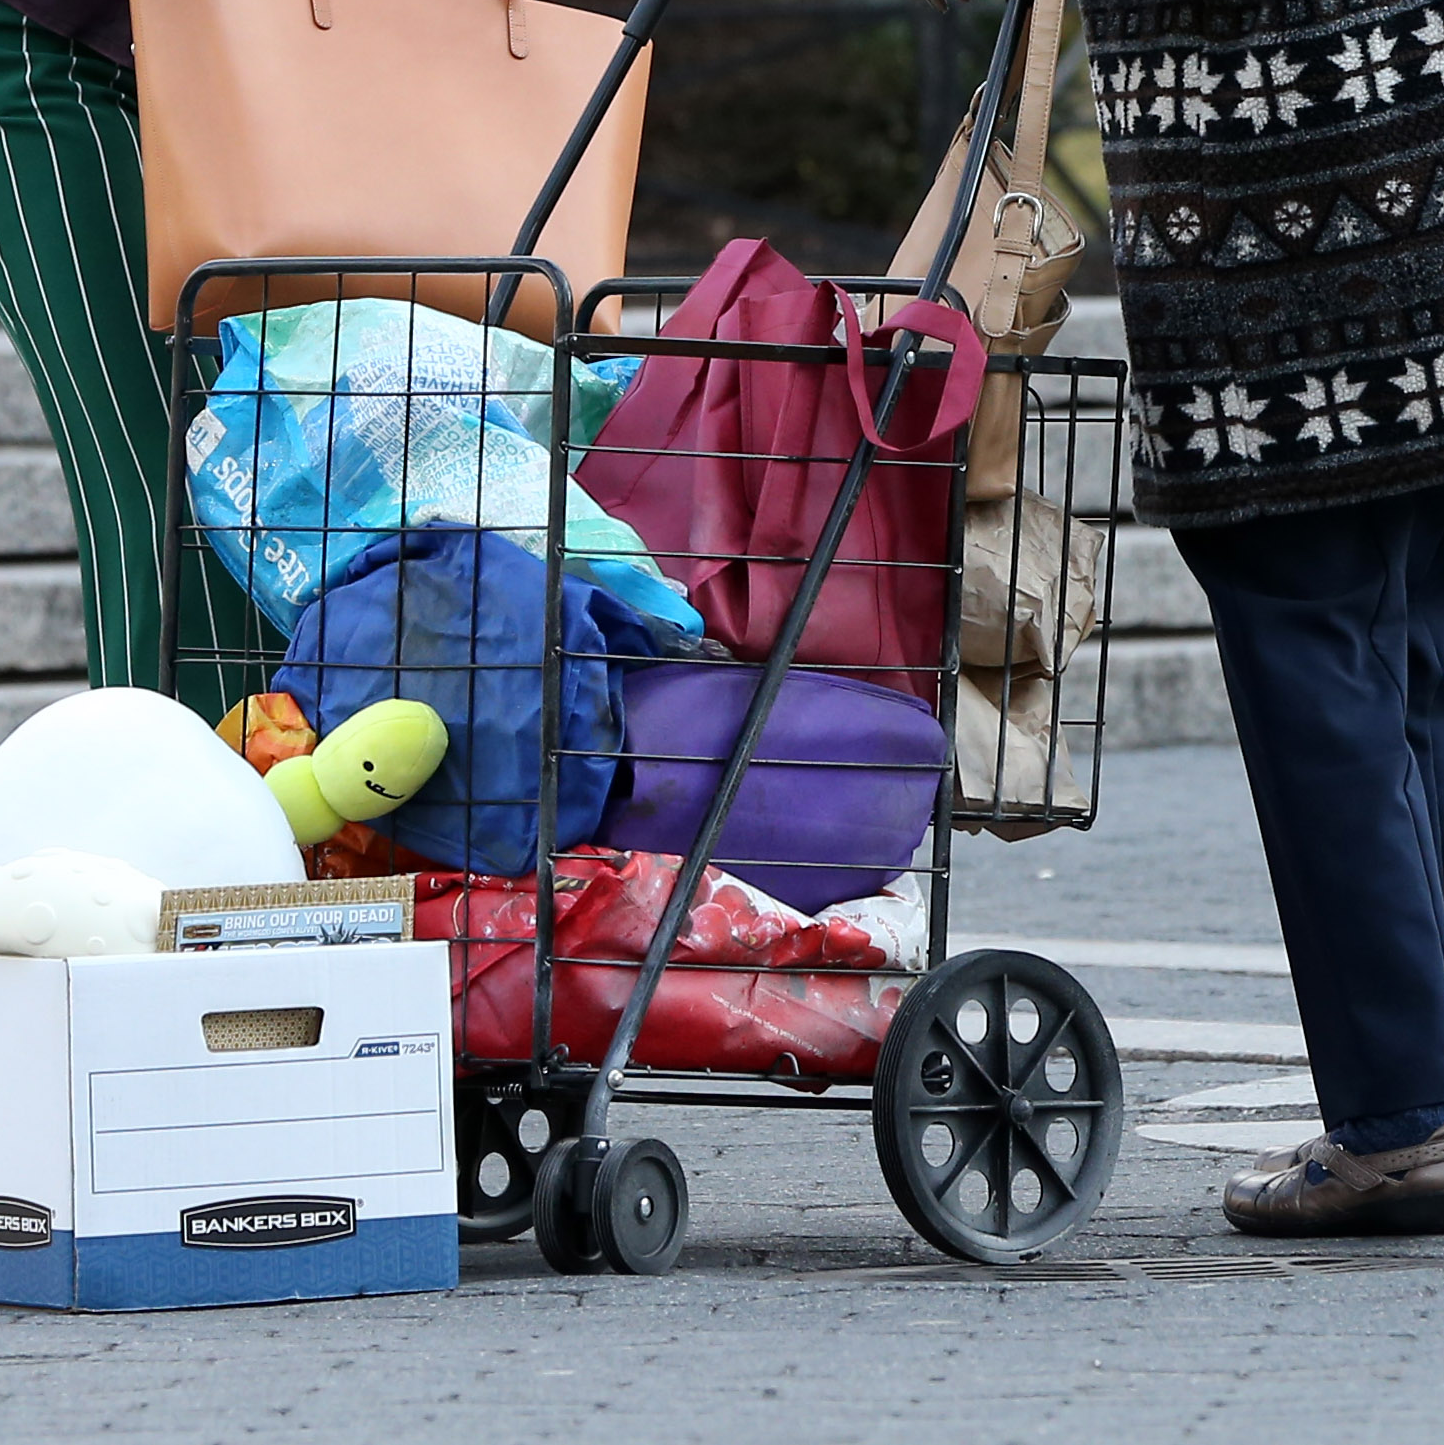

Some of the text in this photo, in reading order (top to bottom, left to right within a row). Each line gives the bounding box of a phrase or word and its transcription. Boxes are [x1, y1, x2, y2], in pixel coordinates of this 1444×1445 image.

[357, 415, 384, 443] ISLAN
[264, 537, 310, 606] Tree
[224, 908, 395, 930] BRING OUT YOUR DEAD!
[21, 1217, 47, 1234] BOX
[192, 1209, 348, 1235] BANKERS BOX
